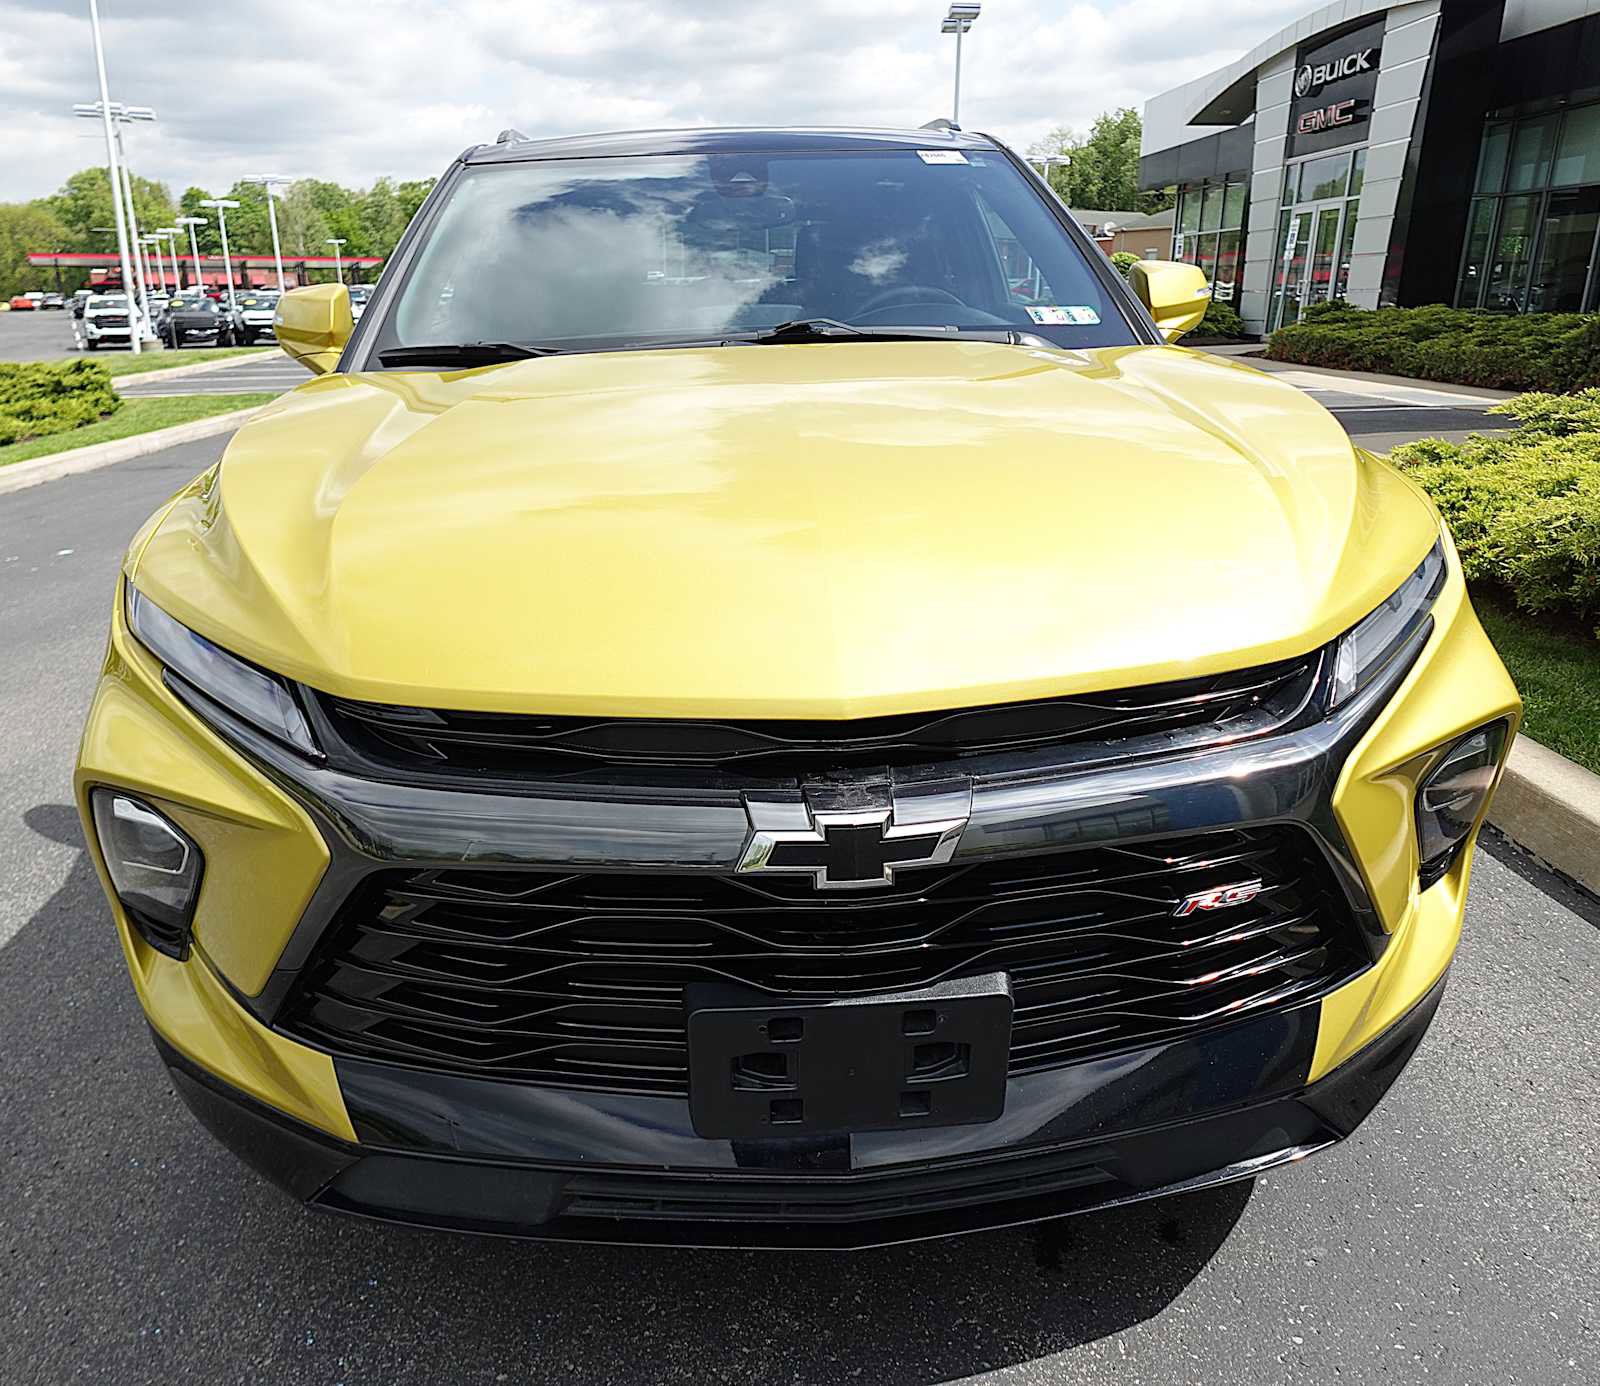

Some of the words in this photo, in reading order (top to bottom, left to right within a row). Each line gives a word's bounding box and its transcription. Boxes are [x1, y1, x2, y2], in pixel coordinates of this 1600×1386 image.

[1312, 48, 1372, 86] BUICK
[1297, 99, 1355, 134] GMC
[1173, 883, 1262, 917] RS
